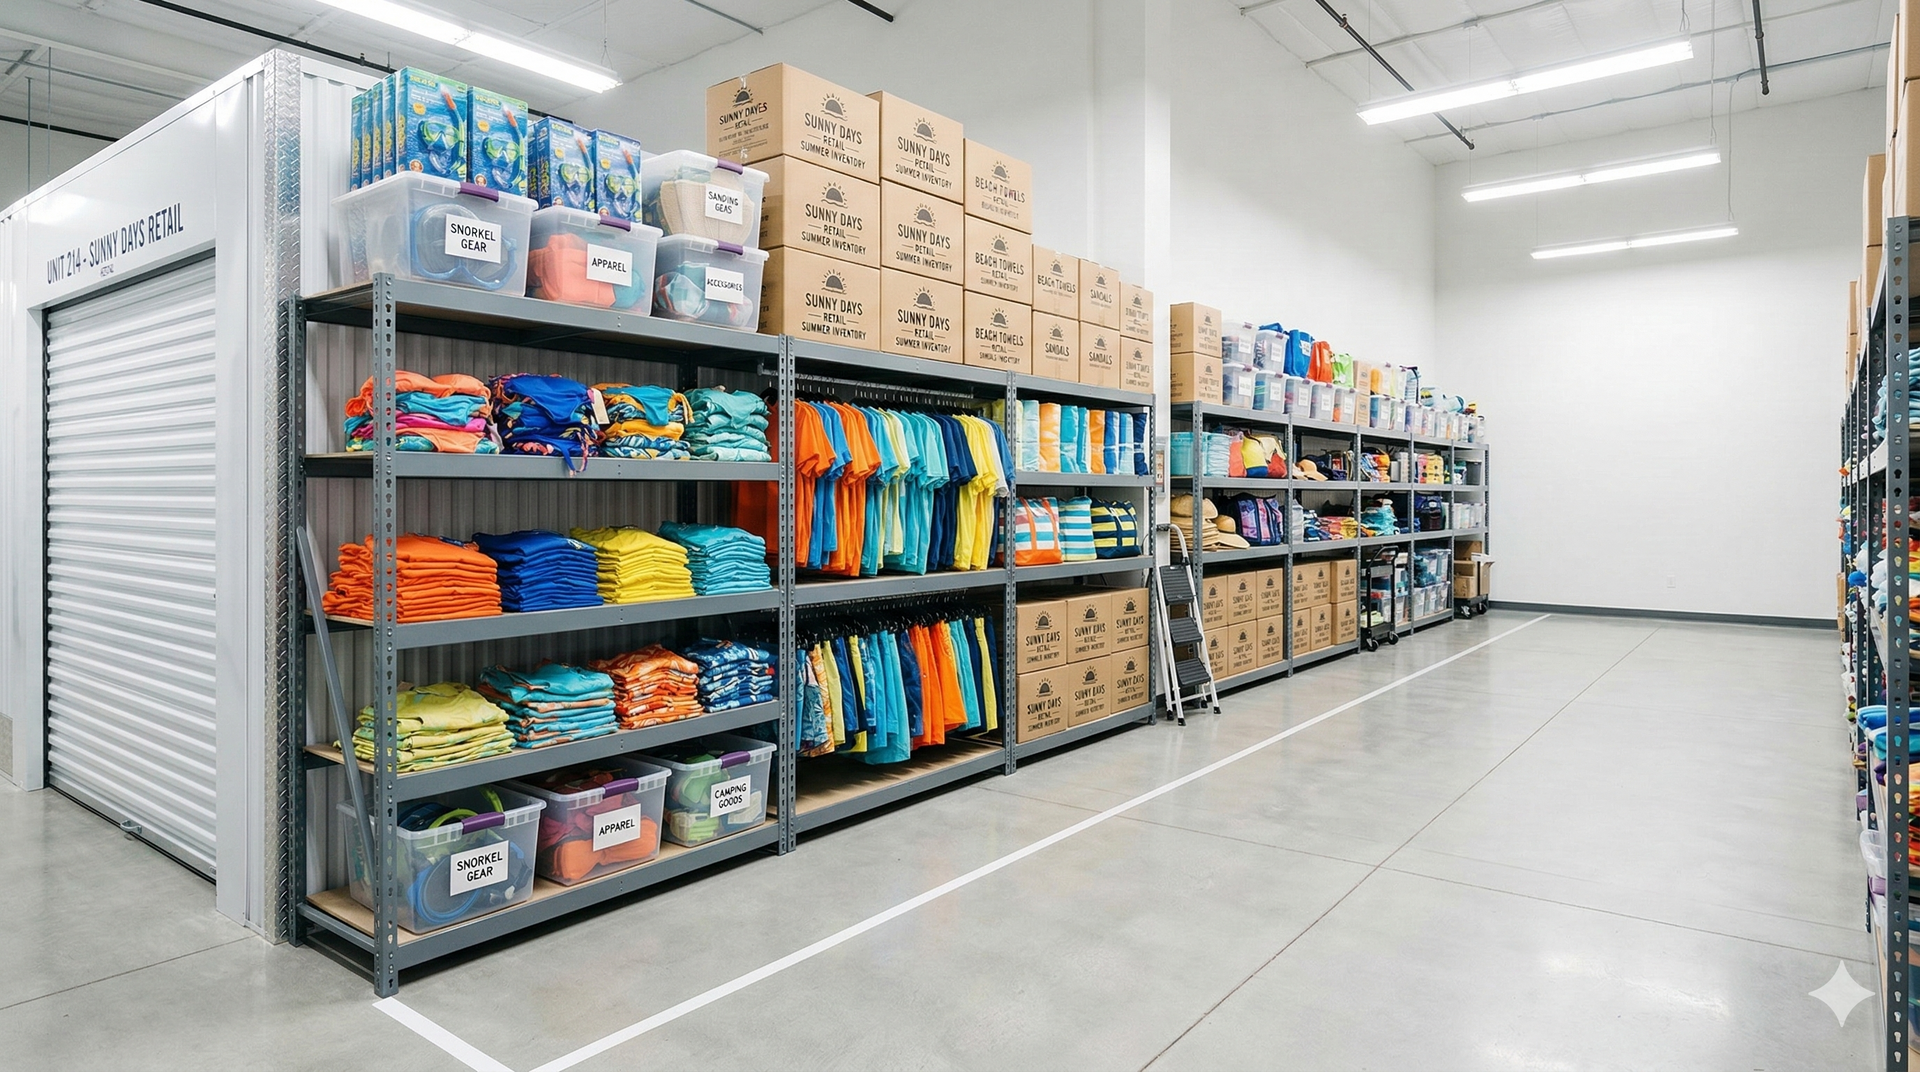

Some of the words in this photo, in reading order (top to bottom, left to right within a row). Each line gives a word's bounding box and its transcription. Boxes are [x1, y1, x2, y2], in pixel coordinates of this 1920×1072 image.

[719, 109, 744, 125] SUNNY
[804, 112, 837, 136] SUNNY
[839, 124, 862, 144] DAYS
[823, 136, 845, 151] RETAIL
[898, 136, 928, 157] SUNNY
[929, 148, 951, 167] DAYS
[800, 140, 829, 158] SUMMER
[831, 150, 866, 170] INVENTORY
[914, 158, 935, 174] RETAIL
[896, 164, 920, 179] SUMMER
[922, 172, 952, 190] INVENTORY
[805, 204, 838, 224] SUNNY
[840, 213, 863, 230] DAYS
[450, 222, 496, 242] SNORKEL
[824, 225, 846, 238] RETAIL
[898, 224, 928, 243] SUNNY
[930, 233, 951, 250] DAYS
[47, 254, 65, 284] UNIT
[67, 247, 82, 276] 214
[89, 230, 118, 268] SUNNY
[122, 218, 145, 254] DAYS
[148, 202, 184, 244] RETAIL
[460, 238, 487, 254] GEAR
[801, 231, 830, 246] SUMMER
[832, 240, 866, 255] INVENTORY
[591, 256, 627, 273] APPAREL
[896, 250, 920, 264] SUMMER
[976, 252, 998, 268] BEACH
[999, 258, 1024, 276] TOWELS
[805, 292, 838, 310] SUNNY
[840, 300, 863, 316] DAYS
[823, 312, 846, 325] RETAIL
[898, 308, 926, 328] SUNNY
[929, 316, 950, 332] DAYS
[802, 322, 830, 334] SUMMER
[832, 327, 866, 340] INVENTORY
[976, 328, 998, 342] BEACH
[999, 332, 1024, 346] TOWELS
[896, 336, 920, 349] SUMMER
[1089, 352, 1112, 366] SANDALS
[714, 783, 747, 800] CAMPING
[718, 794, 743, 810] GOODS
[598, 818, 636, 837] APPAREL
[456, 852, 503, 872] SNORKEL
[466, 866, 494, 882] GEAR
